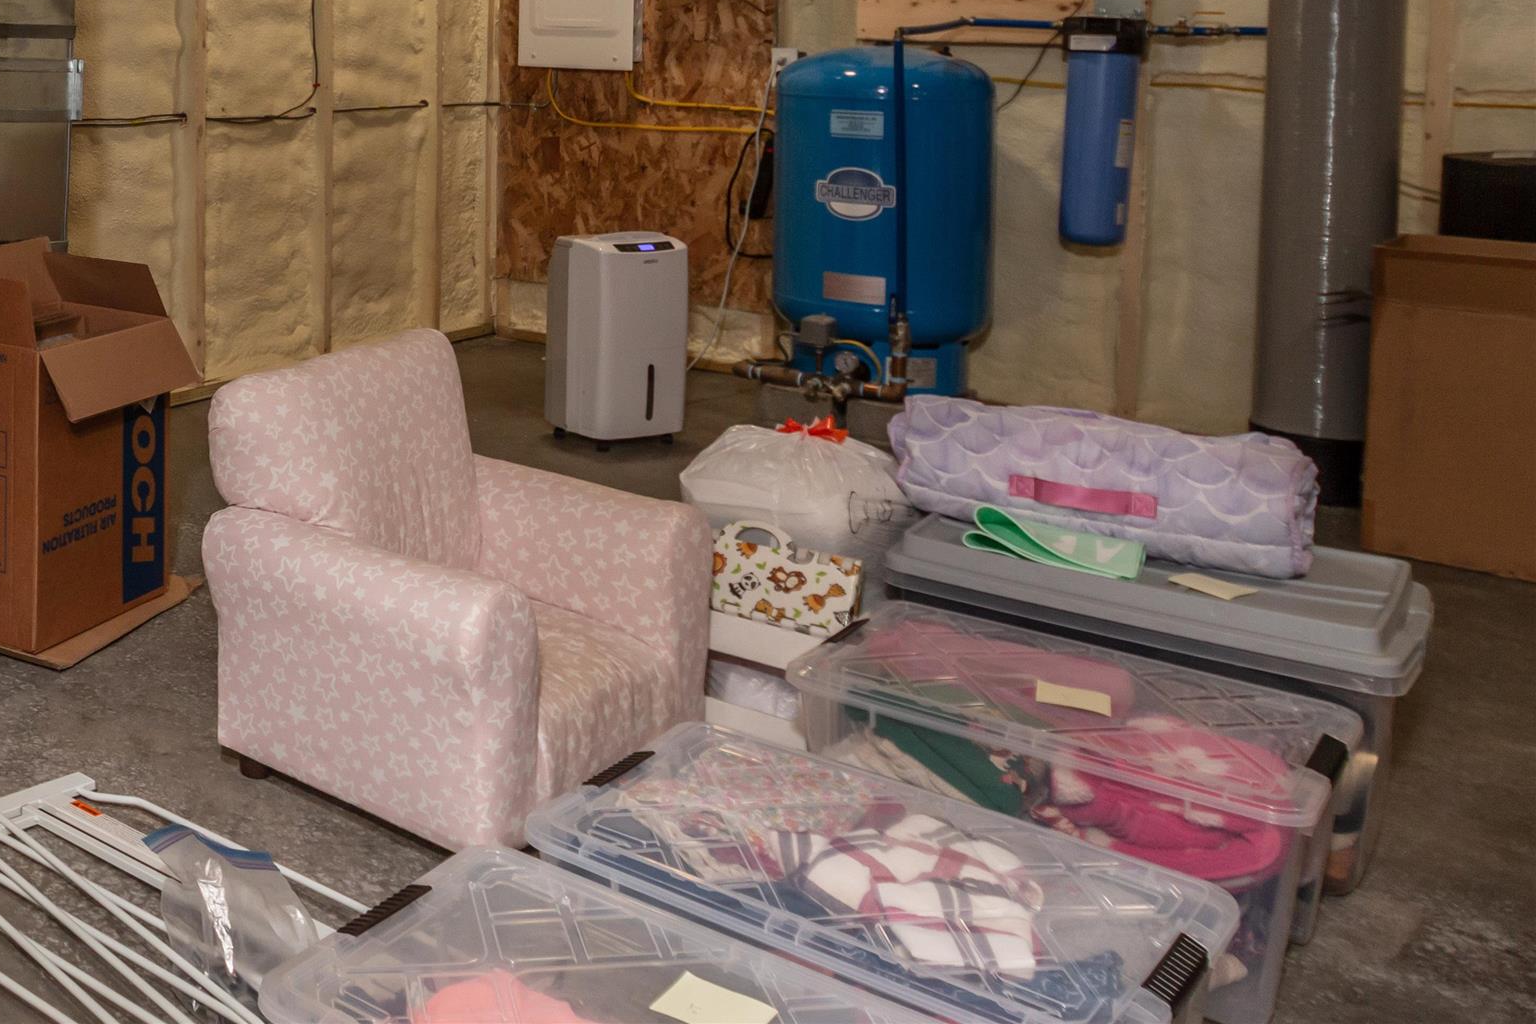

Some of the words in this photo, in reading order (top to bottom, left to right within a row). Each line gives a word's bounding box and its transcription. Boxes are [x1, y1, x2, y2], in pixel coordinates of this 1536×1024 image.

[818, 182, 892, 203] CHALLENGER
[131, 414, 157, 563] OCH
[63, 494, 117, 528] PRODUCTS
[97, 511, 117, 532] AIR
[42, 521, 96, 554] FILTRATION
